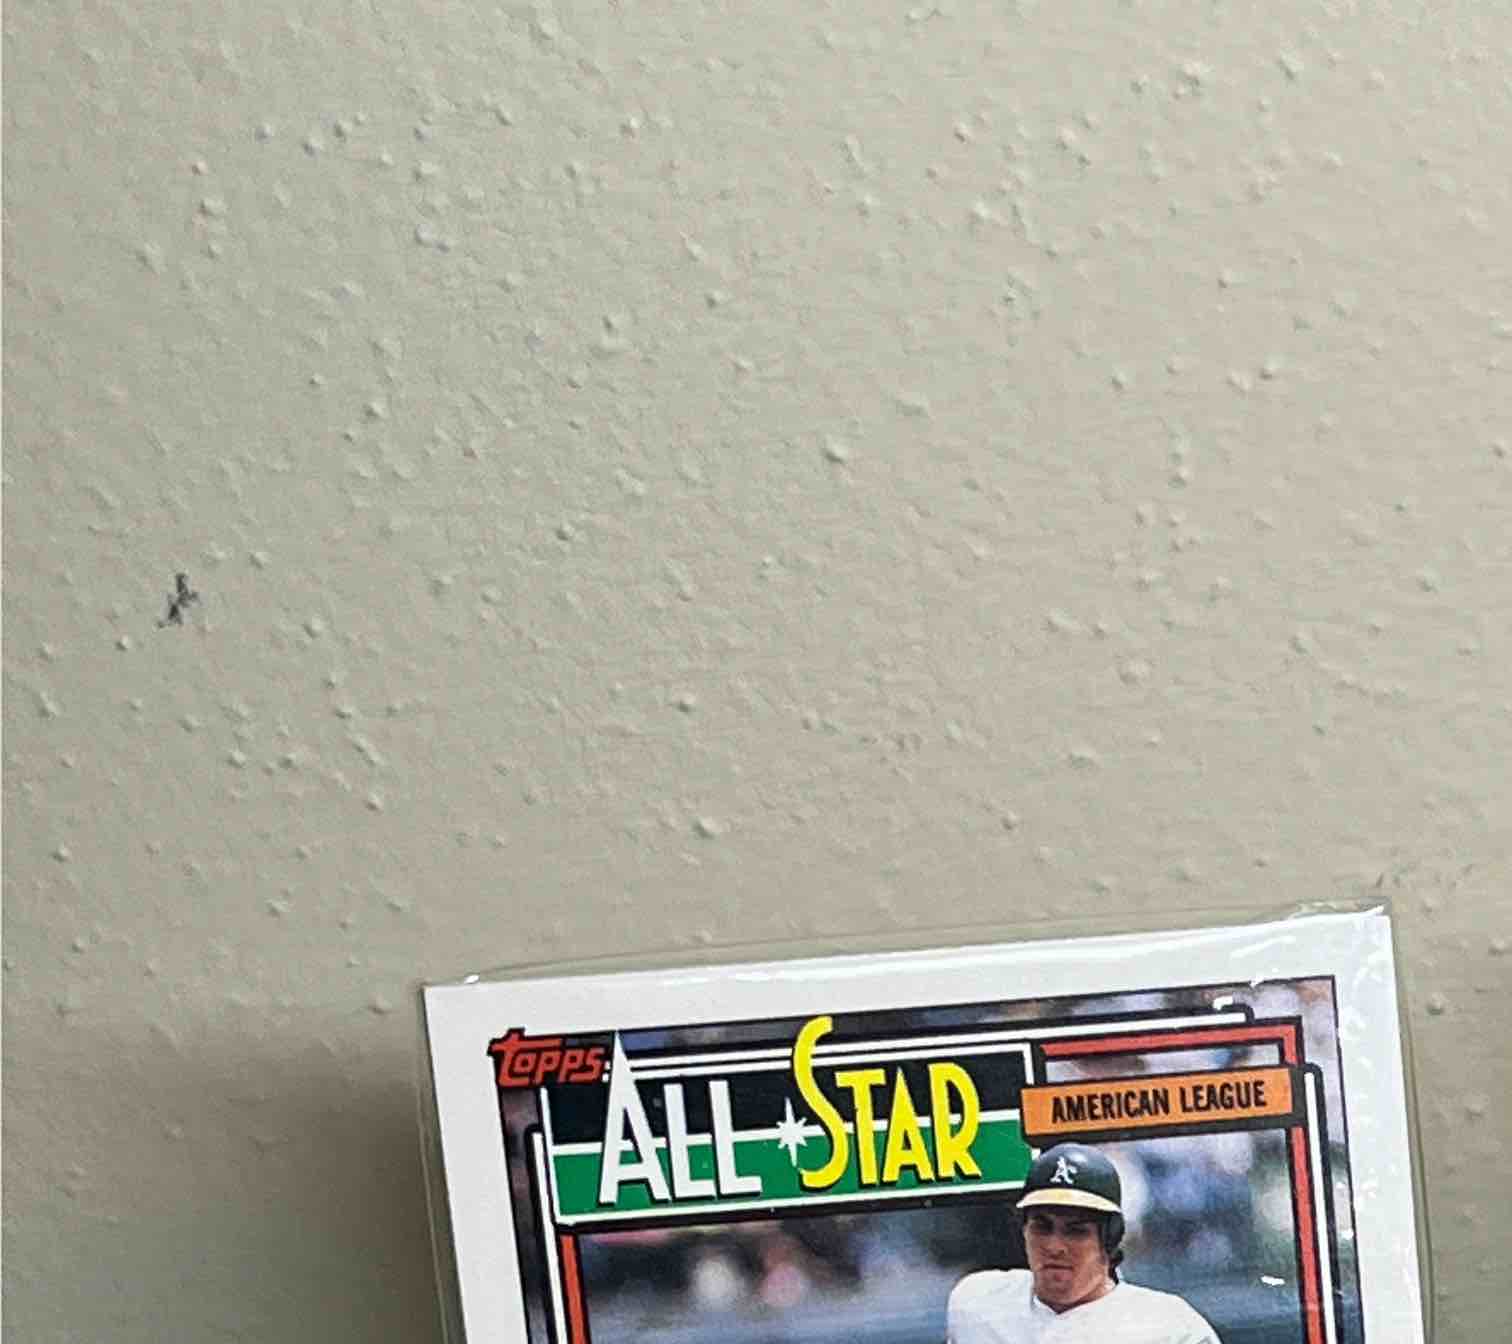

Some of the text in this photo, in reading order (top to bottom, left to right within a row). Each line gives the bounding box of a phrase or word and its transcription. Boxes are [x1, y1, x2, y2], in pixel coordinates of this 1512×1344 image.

[487, 1028, 604, 1087] Topps
[599, 1016, 982, 1204] ALL STAR
[1051, 1080, 1268, 1125] AMERICAN LEAGUE
